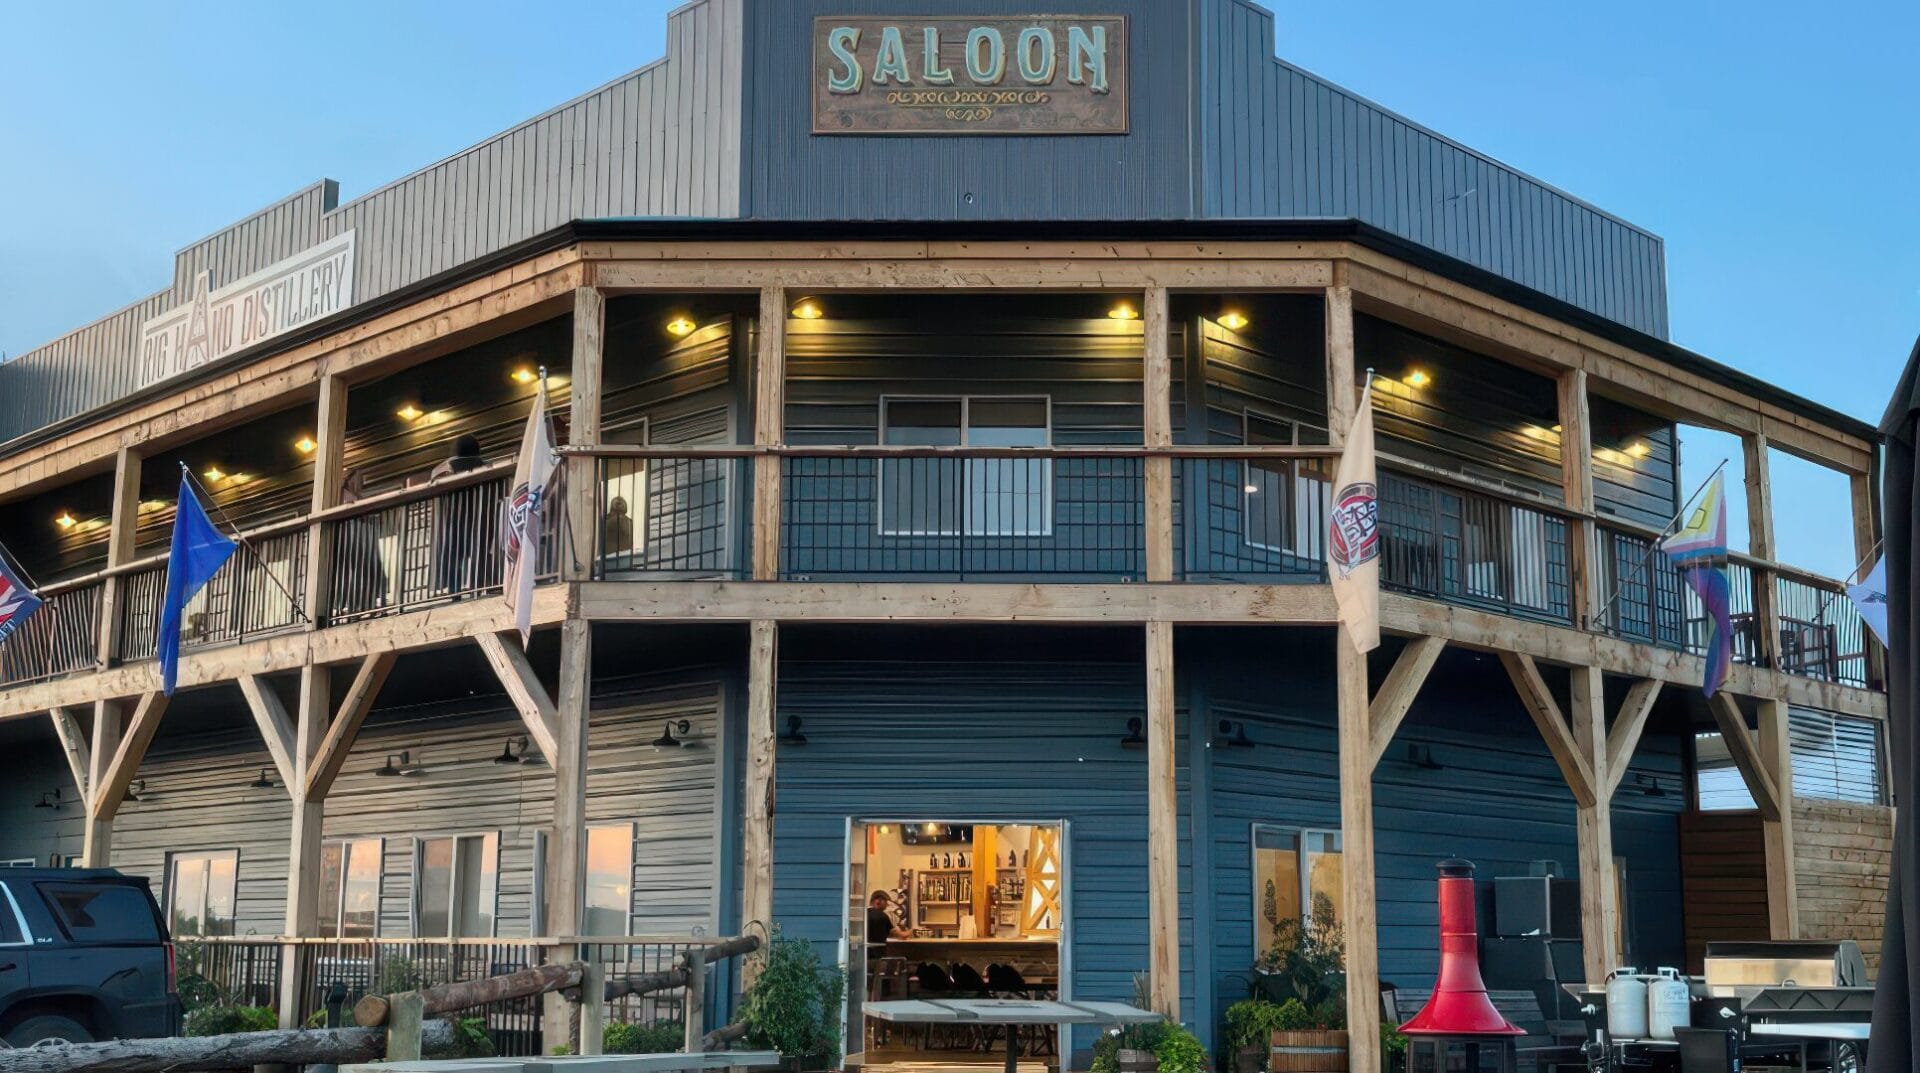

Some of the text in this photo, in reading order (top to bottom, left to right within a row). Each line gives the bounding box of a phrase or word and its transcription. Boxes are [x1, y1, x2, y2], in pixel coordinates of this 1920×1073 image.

[828, 26, 1109, 93] SALOON
[141, 331, 168, 387] RIG
[241, 253, 346, 345] DISTILLERY
